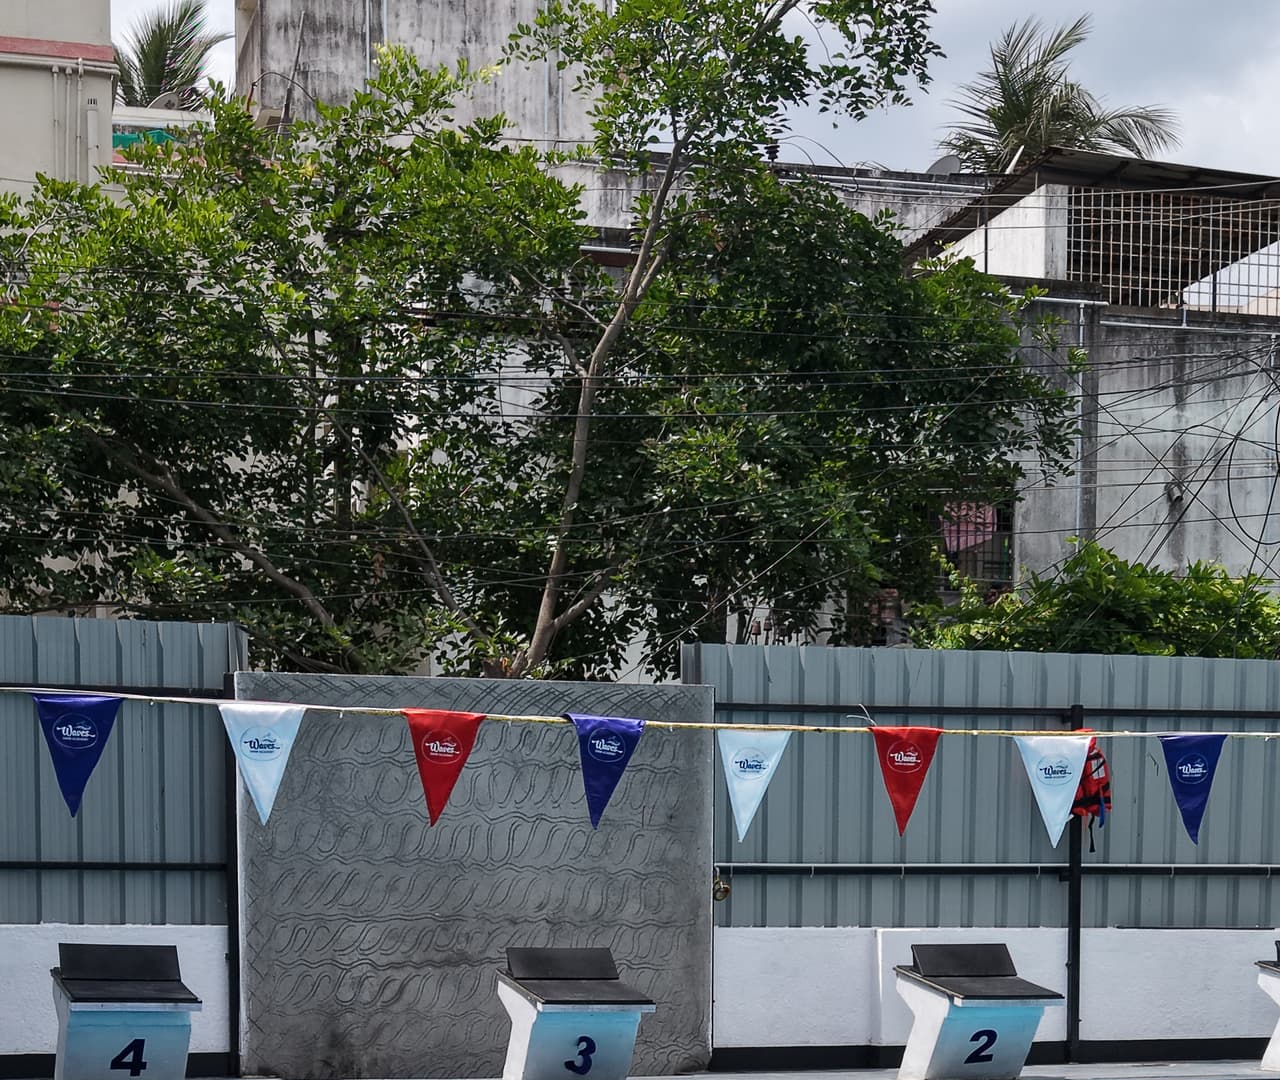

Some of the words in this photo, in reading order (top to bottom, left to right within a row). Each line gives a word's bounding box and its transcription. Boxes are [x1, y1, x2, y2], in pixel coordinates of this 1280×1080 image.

[56, 724, 95, 738] Waves
[244, 737, 280, 750] Waves
[425, 740, 460, 754] Waves
[591, 738, 623, 754] Waves
[735, 758, 766, 770] Waves
[890, 751, 921, 763] Waves
[1039, 765, 1072, 776] Waves
[1178, 765, 1207, 774] Waves
[963, 1029, 997, 1064] 2
[110, 1038, 147, 1077] 4
[564, 1035, 596, 1075] 3
